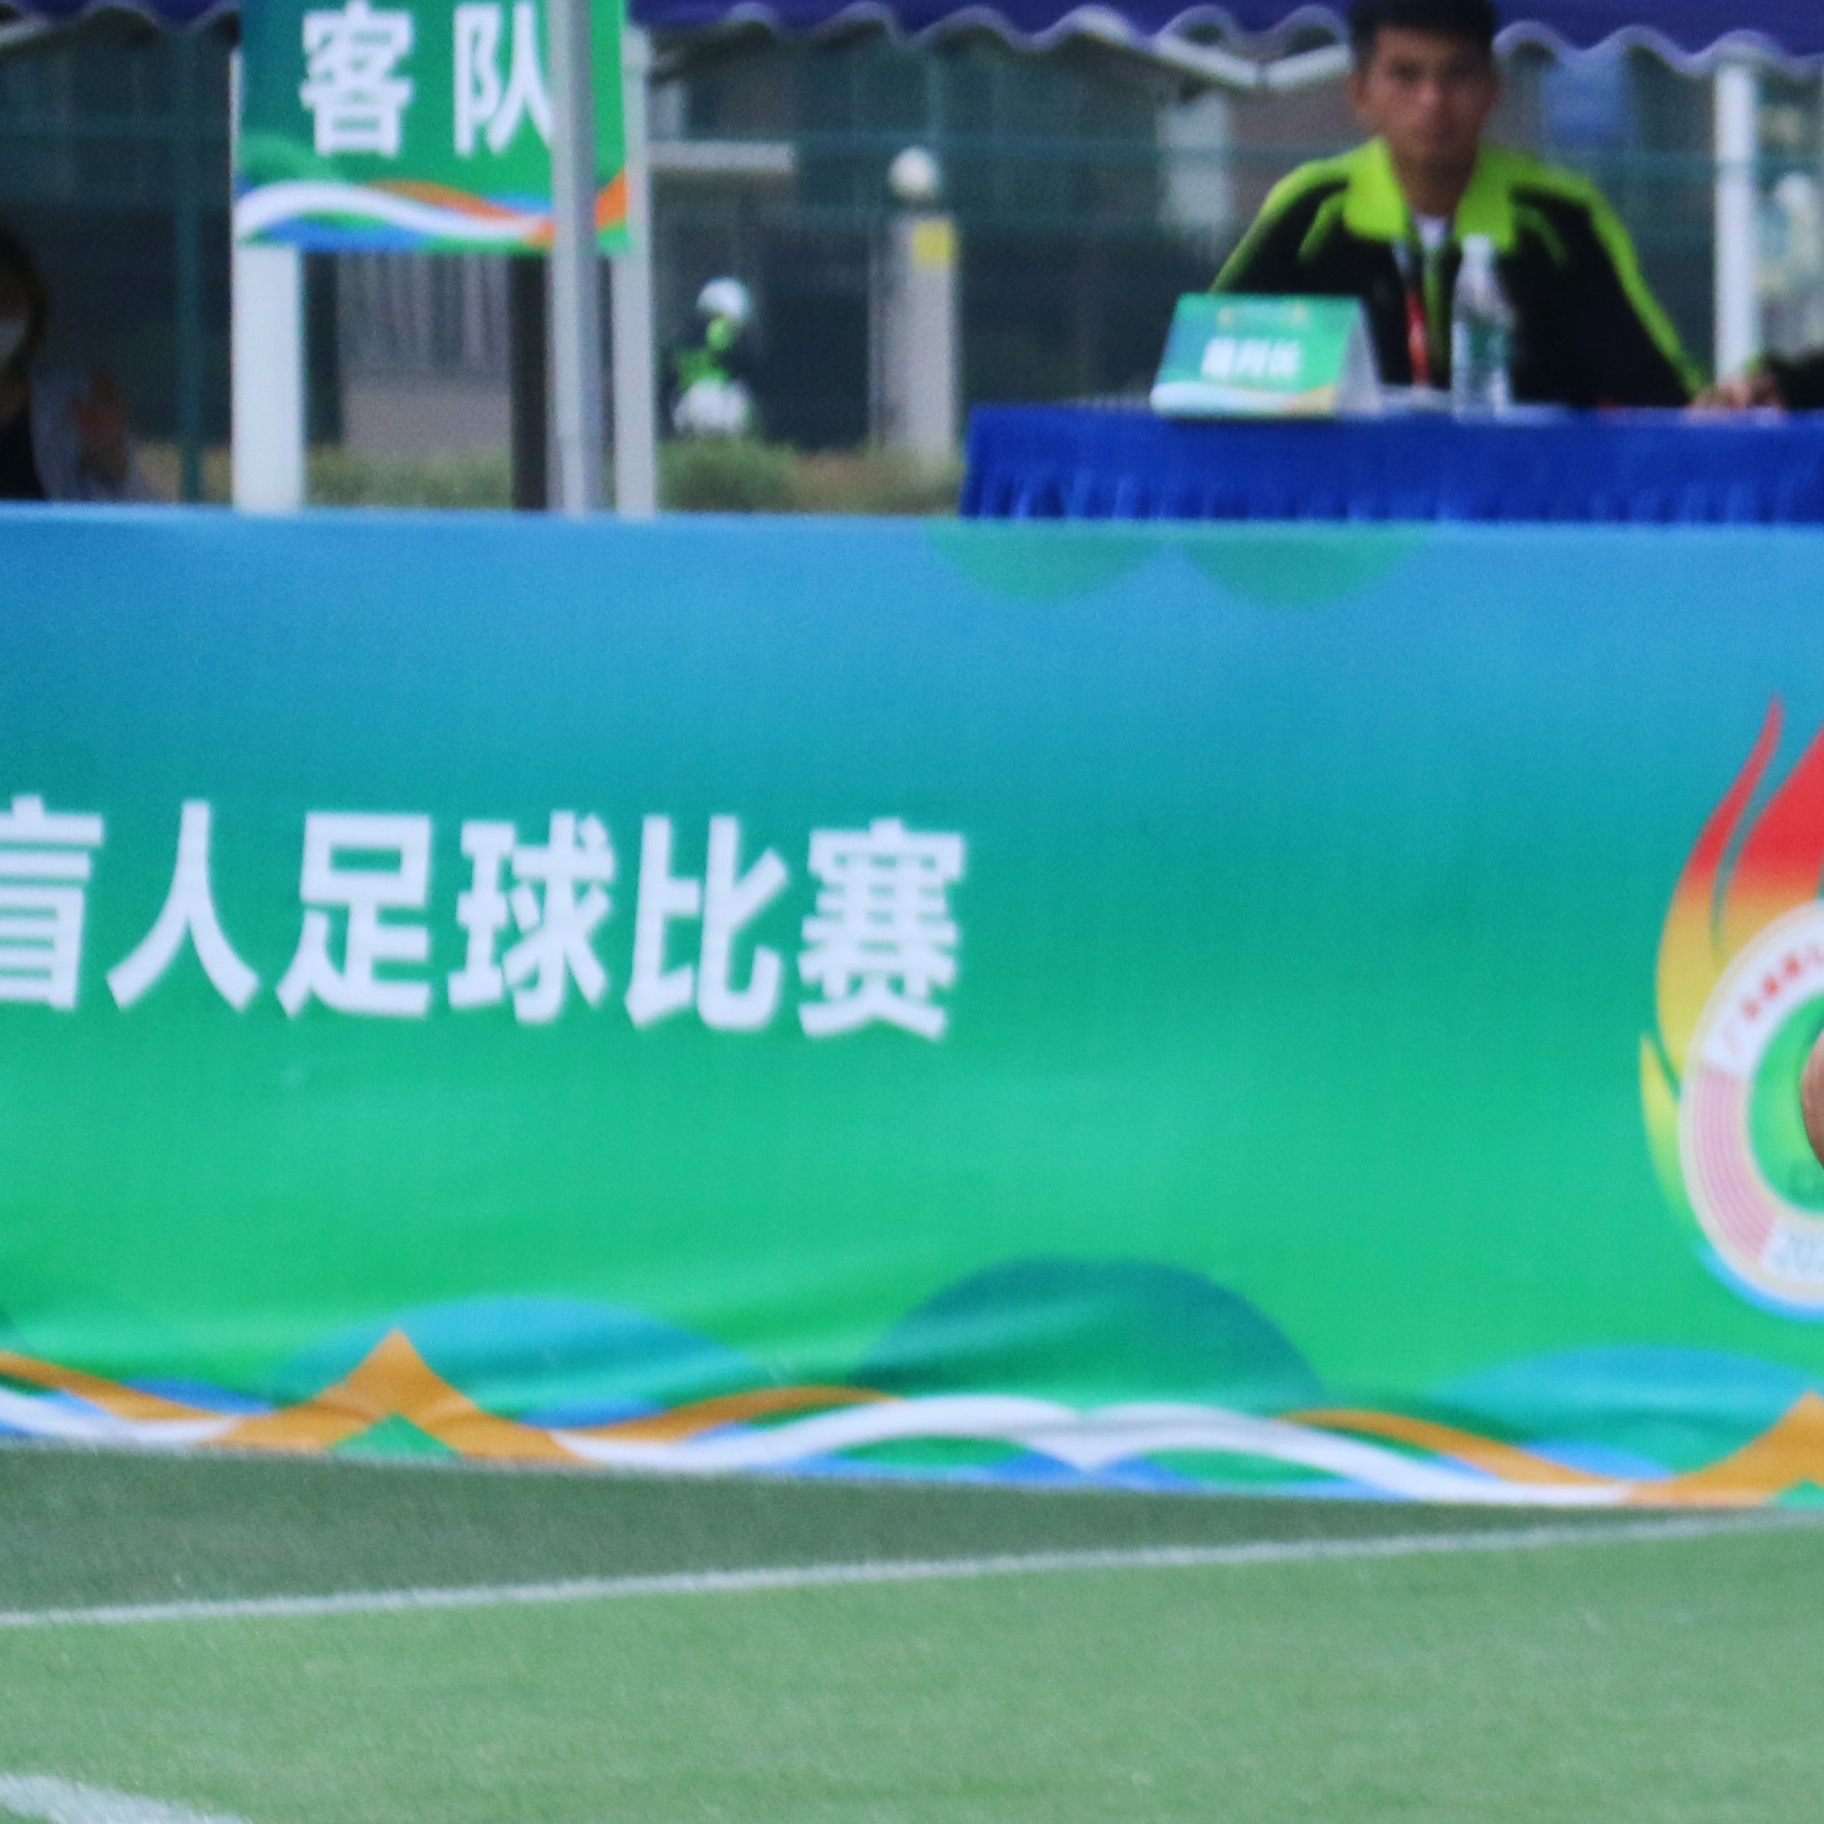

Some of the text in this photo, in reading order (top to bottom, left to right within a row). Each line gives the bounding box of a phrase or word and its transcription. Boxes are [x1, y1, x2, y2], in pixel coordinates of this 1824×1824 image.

[301, 0, 554, 157] 客队
[0, 793, 967, 1040] 盲人足球比赛
